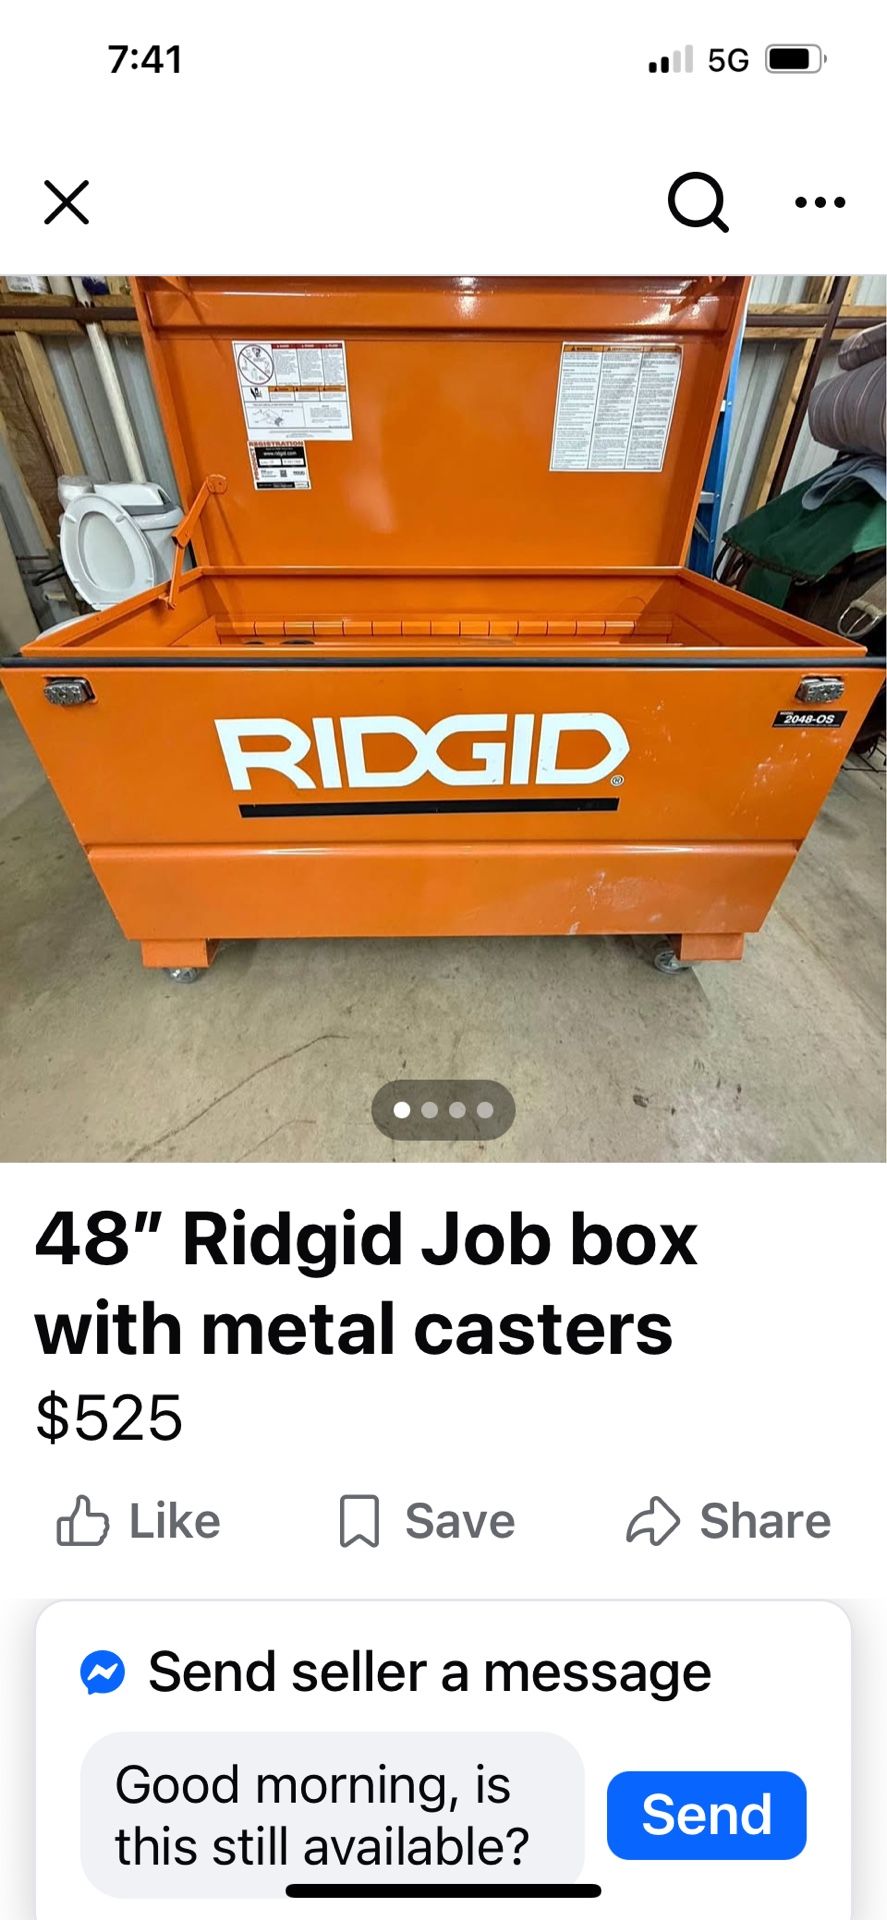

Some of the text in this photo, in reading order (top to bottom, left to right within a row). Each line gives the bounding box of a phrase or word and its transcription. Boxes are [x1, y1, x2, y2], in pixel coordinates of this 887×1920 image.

[109, 45, 180, 73] 7:41
[709, 48, 749, 72] 5G
[784, 714, 835, 724] 2048-OS
[215, 713, 629, 791] RIDGID
[185, 1209, 402, 1279] Ridgid
[421, 1210, 551, 1266] Job
[572, 1210, 698, 1266] box
[34, 1298, 673, 1356] with metal casters
[36, 1389, 182, 1445] $525
[131, 1500, 221, 1539] Like
[406, 1502, 515, 1539] Save
[700, 1501, 831, 1539] Share
[149, 1649, 711, 1702] Send seller a message
[116, 1763, 511, 1813] Good morning, is
[642, 1792, 771, 1836] Send
[114, 1825, 529, 1866] this still available?
